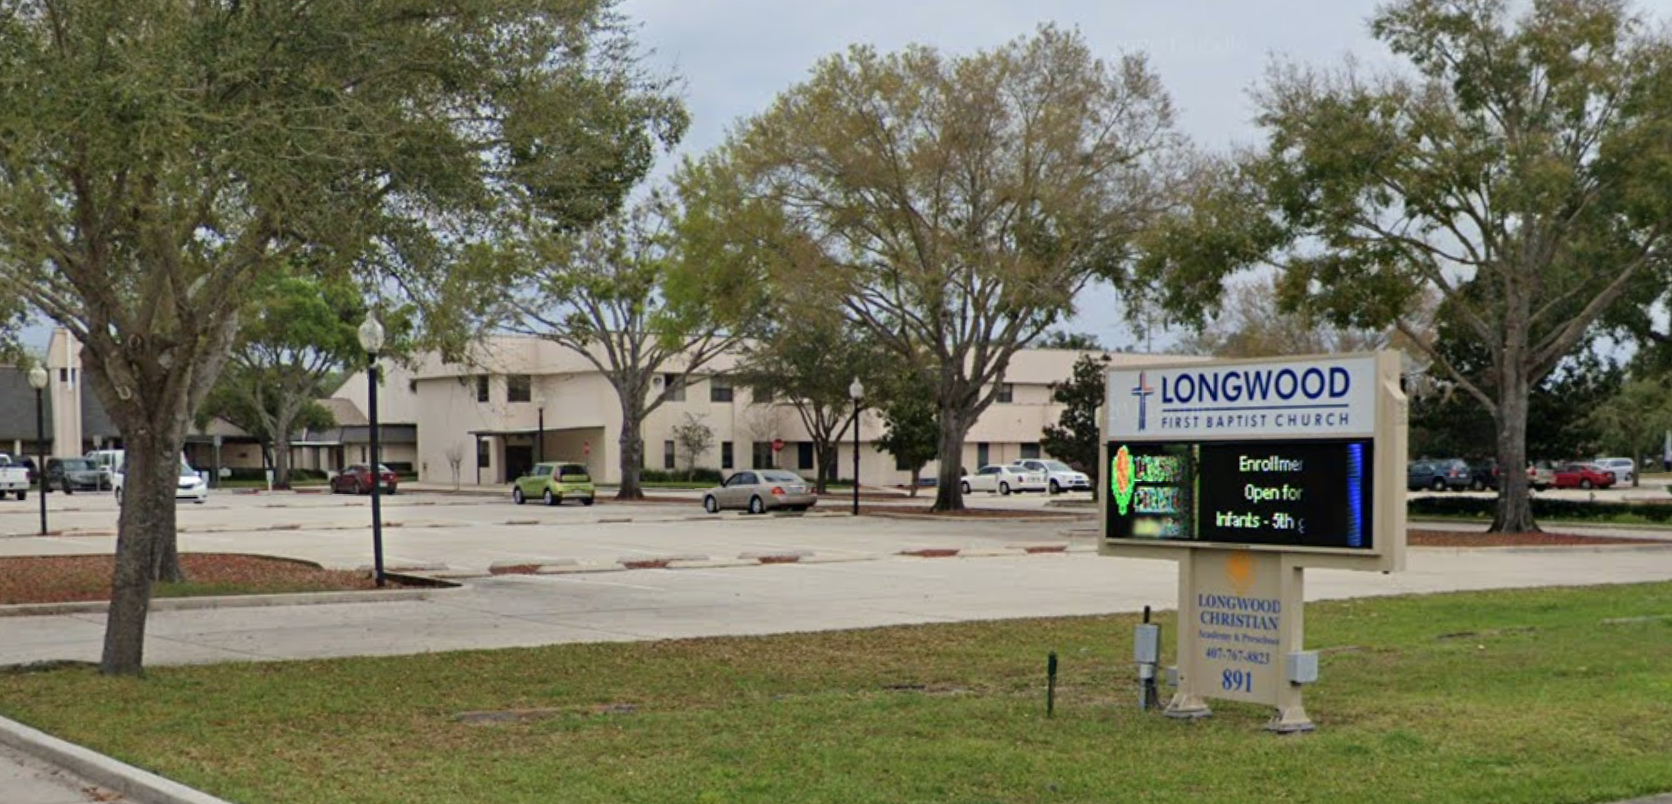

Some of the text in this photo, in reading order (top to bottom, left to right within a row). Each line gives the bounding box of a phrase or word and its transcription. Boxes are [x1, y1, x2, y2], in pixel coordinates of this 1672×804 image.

[1162, 367, 1350, 403] LONGWOOD
[1162, 412, 1349, 428] FIRST BAPTIST CHURCH
[1244, 484, 1303, 503] Open for
[1216, 511, 1260, 528] Infants
[1272, 512, 1294, 529] 5th
[1199, 594, 1281, 613] LONGWOOD
[1200, 611, 1279, 630] CHRISTIAN
[1222, 668, 1252, 692] 891
